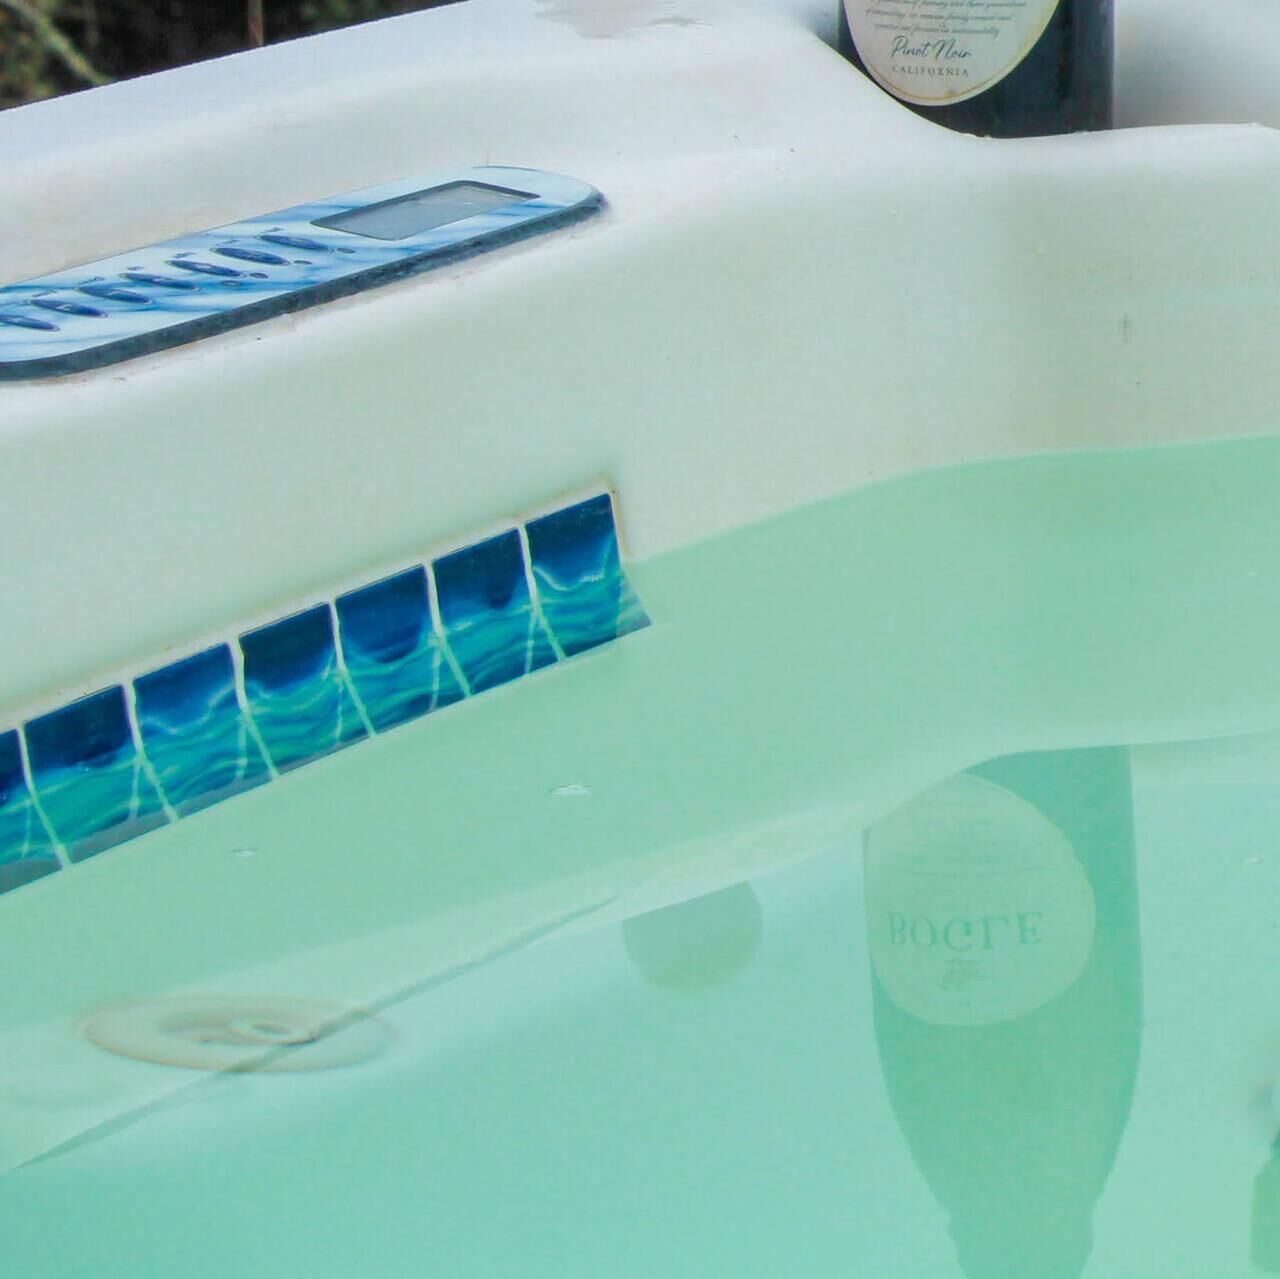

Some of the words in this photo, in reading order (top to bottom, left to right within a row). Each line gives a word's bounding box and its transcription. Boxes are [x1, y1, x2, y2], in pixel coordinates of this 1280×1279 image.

[891, 35, 930, 59] Pinot
[932, 39, 973, 60] Noir
[892, 64, 969, 78] CALIFORNIA
